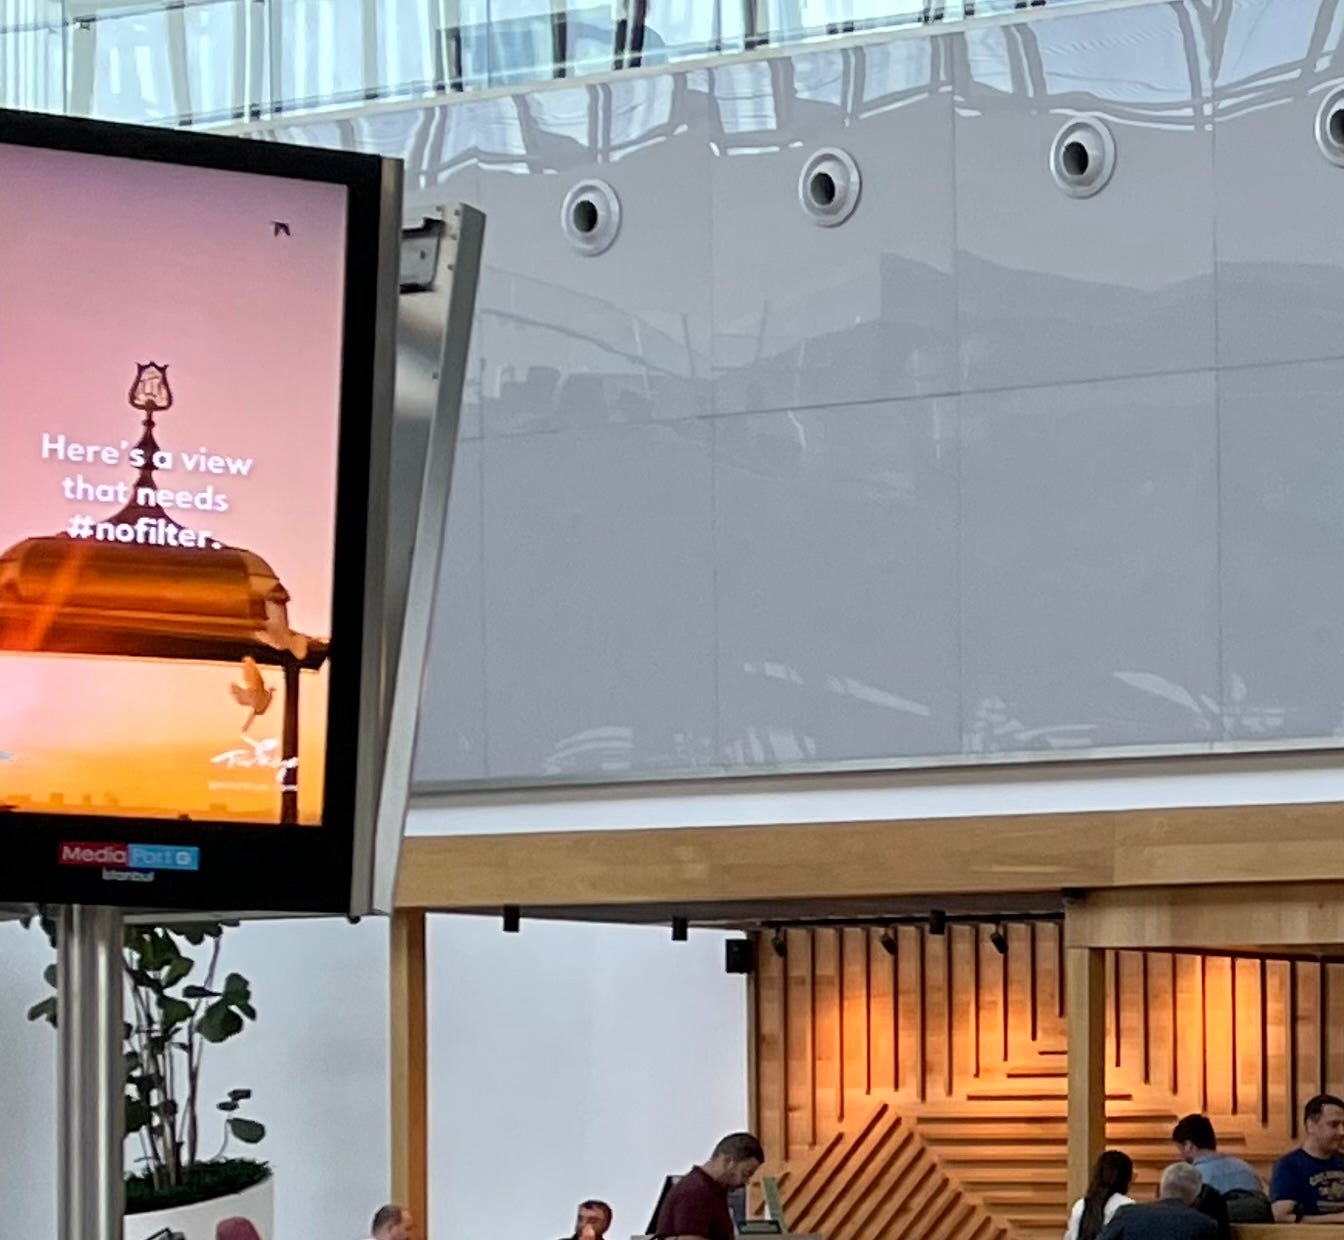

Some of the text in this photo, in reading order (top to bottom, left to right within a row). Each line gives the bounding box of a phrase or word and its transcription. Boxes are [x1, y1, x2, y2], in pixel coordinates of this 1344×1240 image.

[41, 433, 252, 475] Here's a view
[62, 474, 229, 512] that needs
[67, 514, 222, 549] #nofilter.
[62, 845, 127, 863] Media
